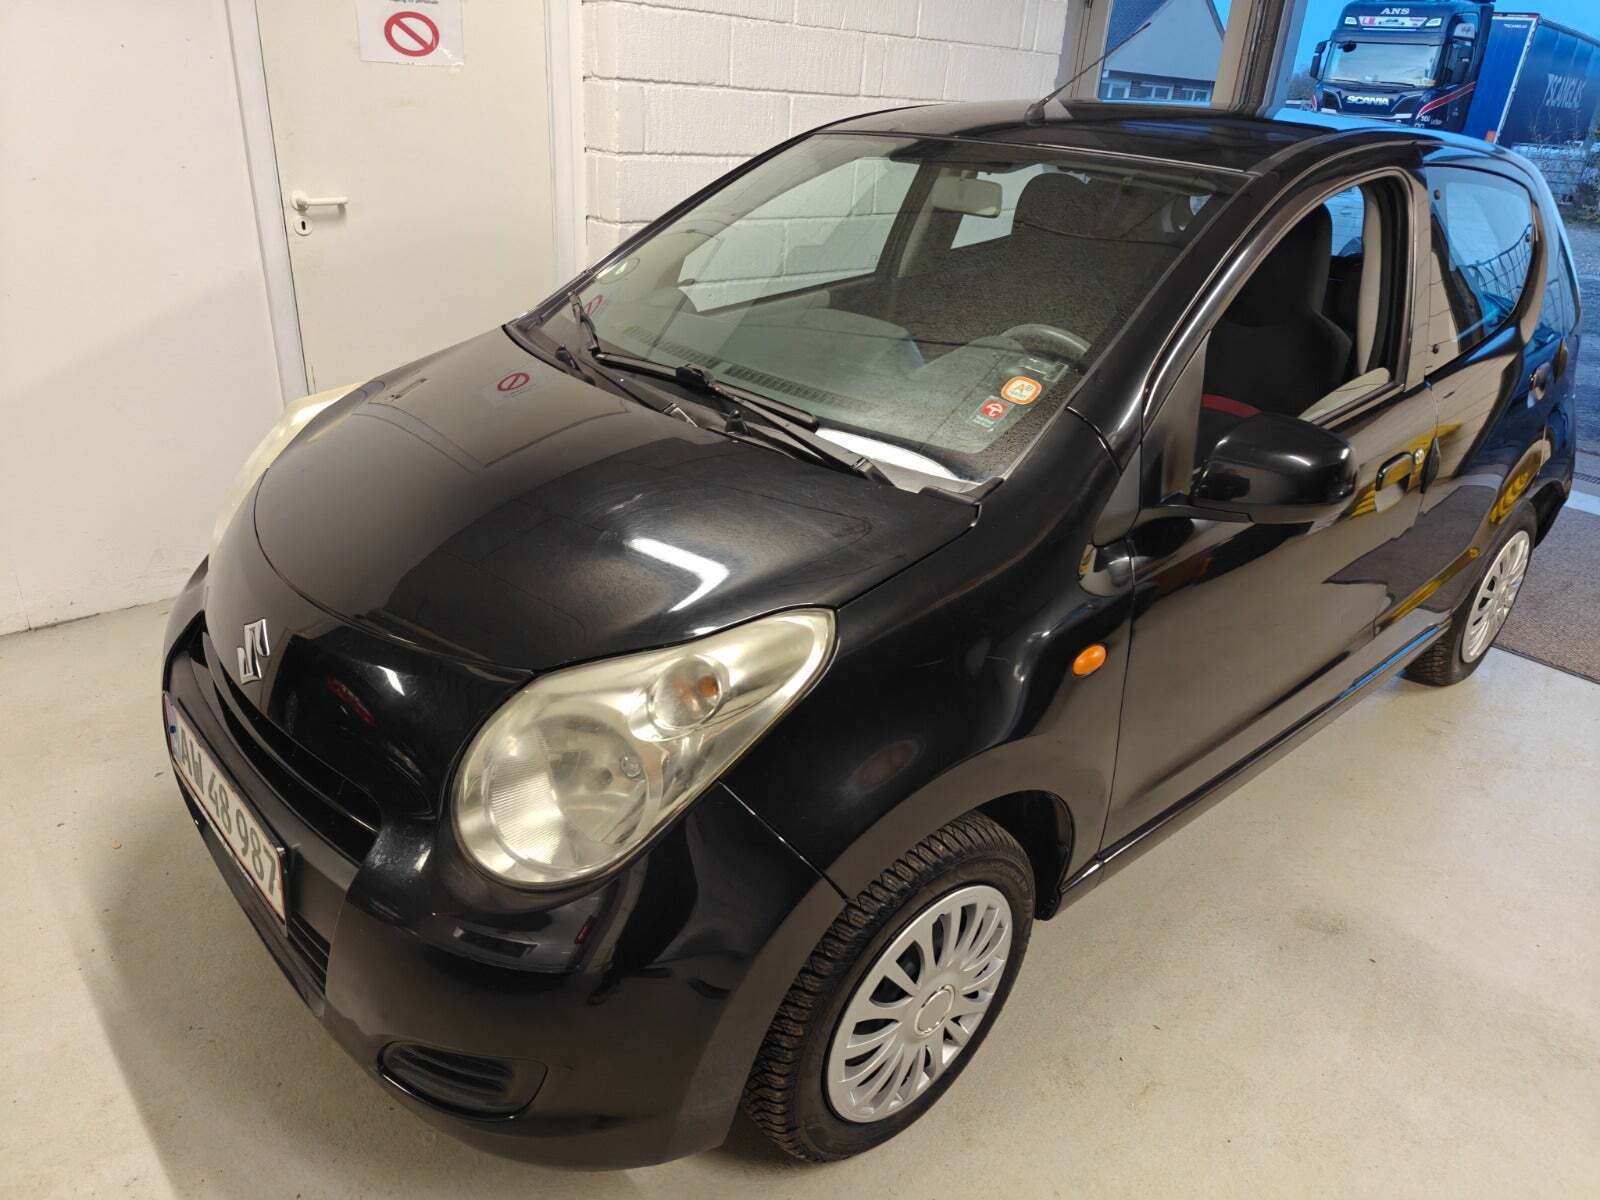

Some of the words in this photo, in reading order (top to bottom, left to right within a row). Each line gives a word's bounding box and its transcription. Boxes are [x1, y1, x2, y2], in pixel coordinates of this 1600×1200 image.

[1380, 7, 1410, 15] ANS
[1346, 95, 1389, 106] SCANIA
[208, 772, 232, 835] 48
[236, 808, 276, 895] 987
